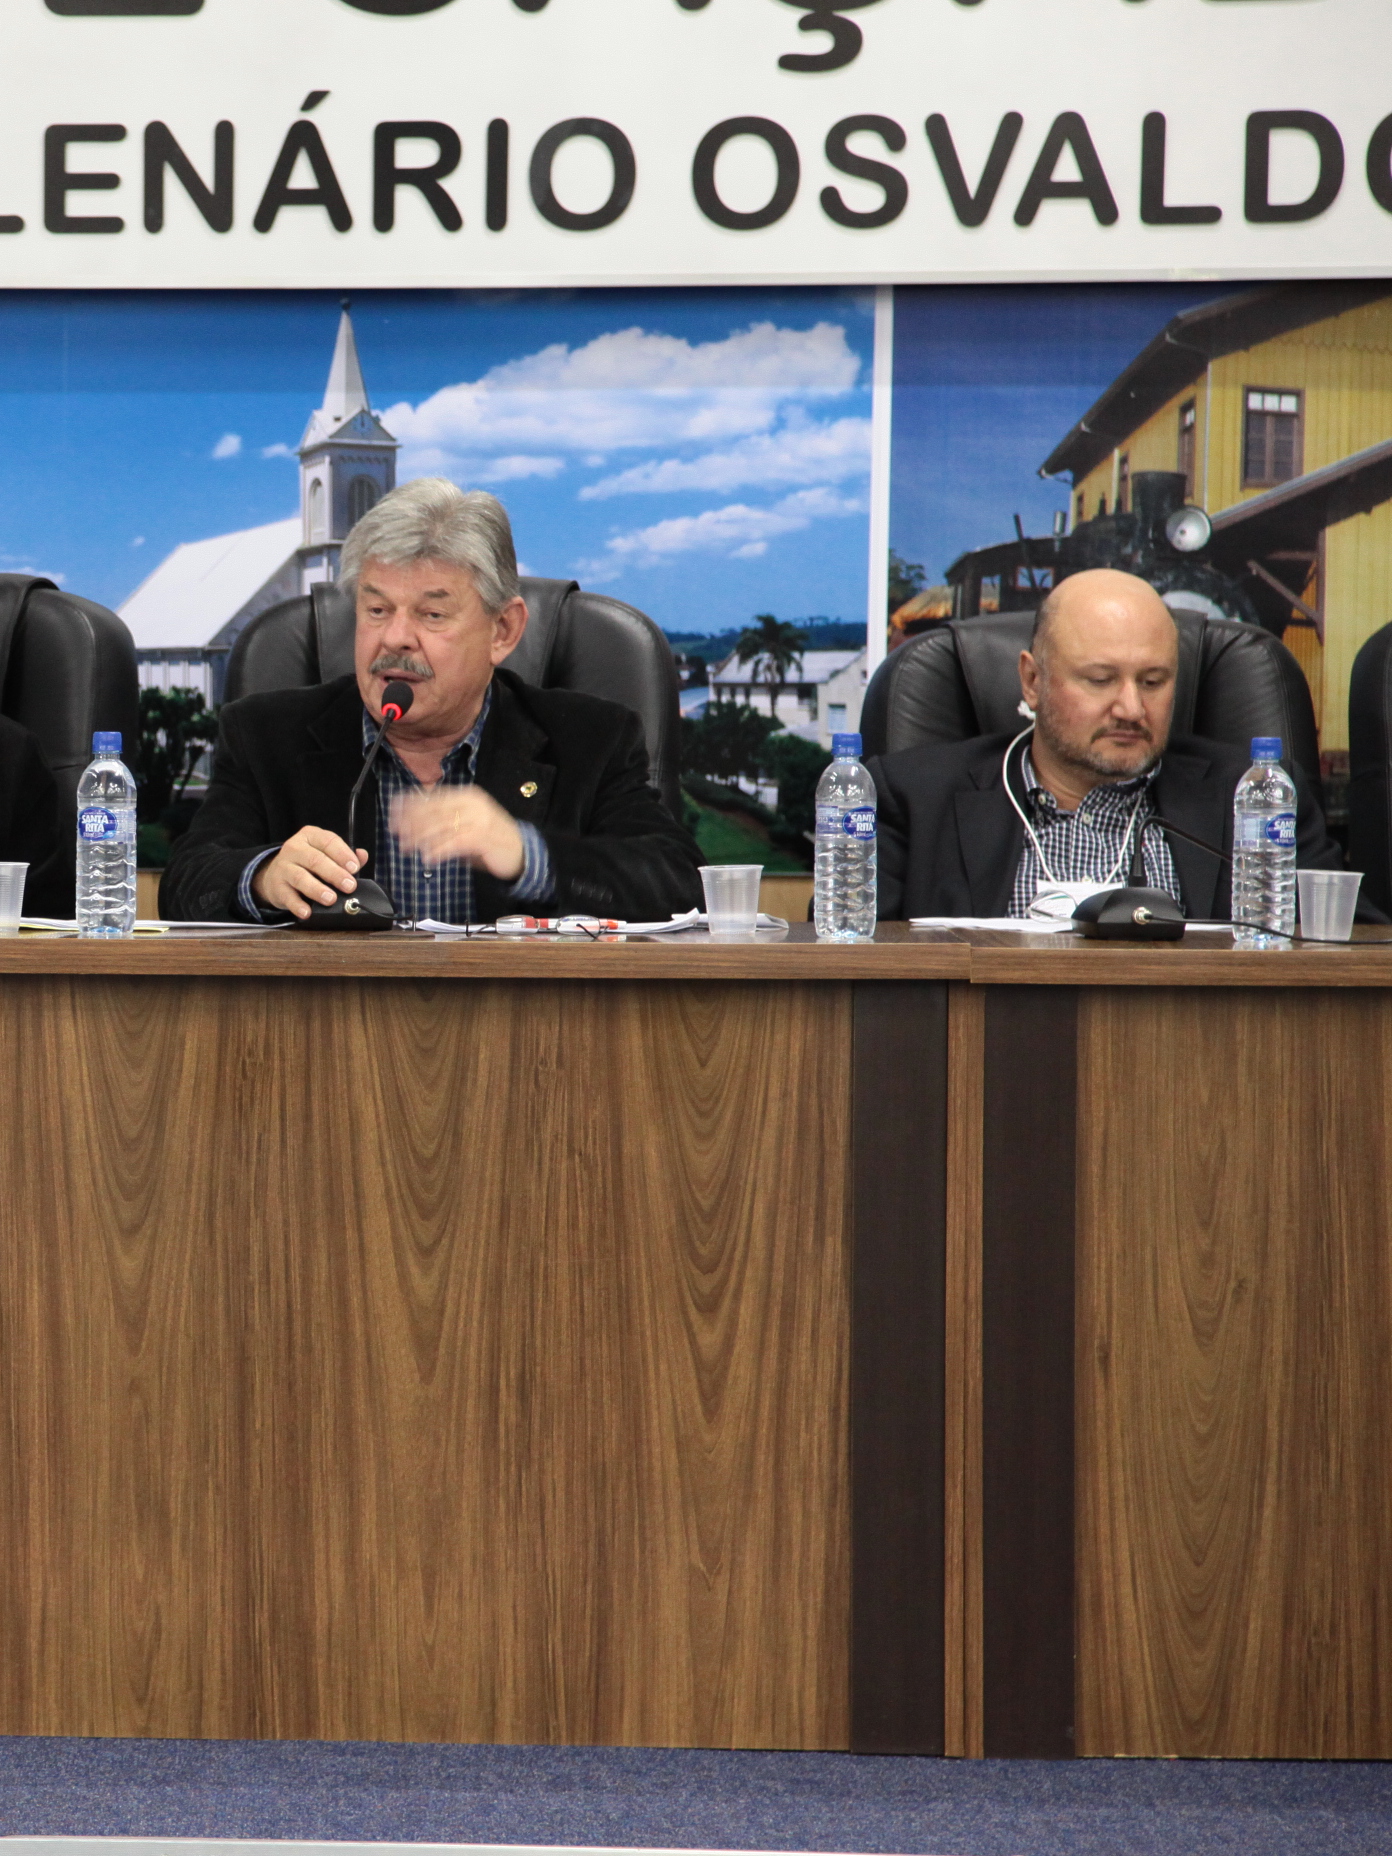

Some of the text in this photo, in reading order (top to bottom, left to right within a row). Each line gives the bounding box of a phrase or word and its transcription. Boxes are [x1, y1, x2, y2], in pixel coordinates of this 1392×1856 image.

[691, 110, 1392, 231] OSVALD
[81, 814, 109, 824] SANTA
[85, 823, 105, 833] RITA
[856, 822, 874, 832] RITA
